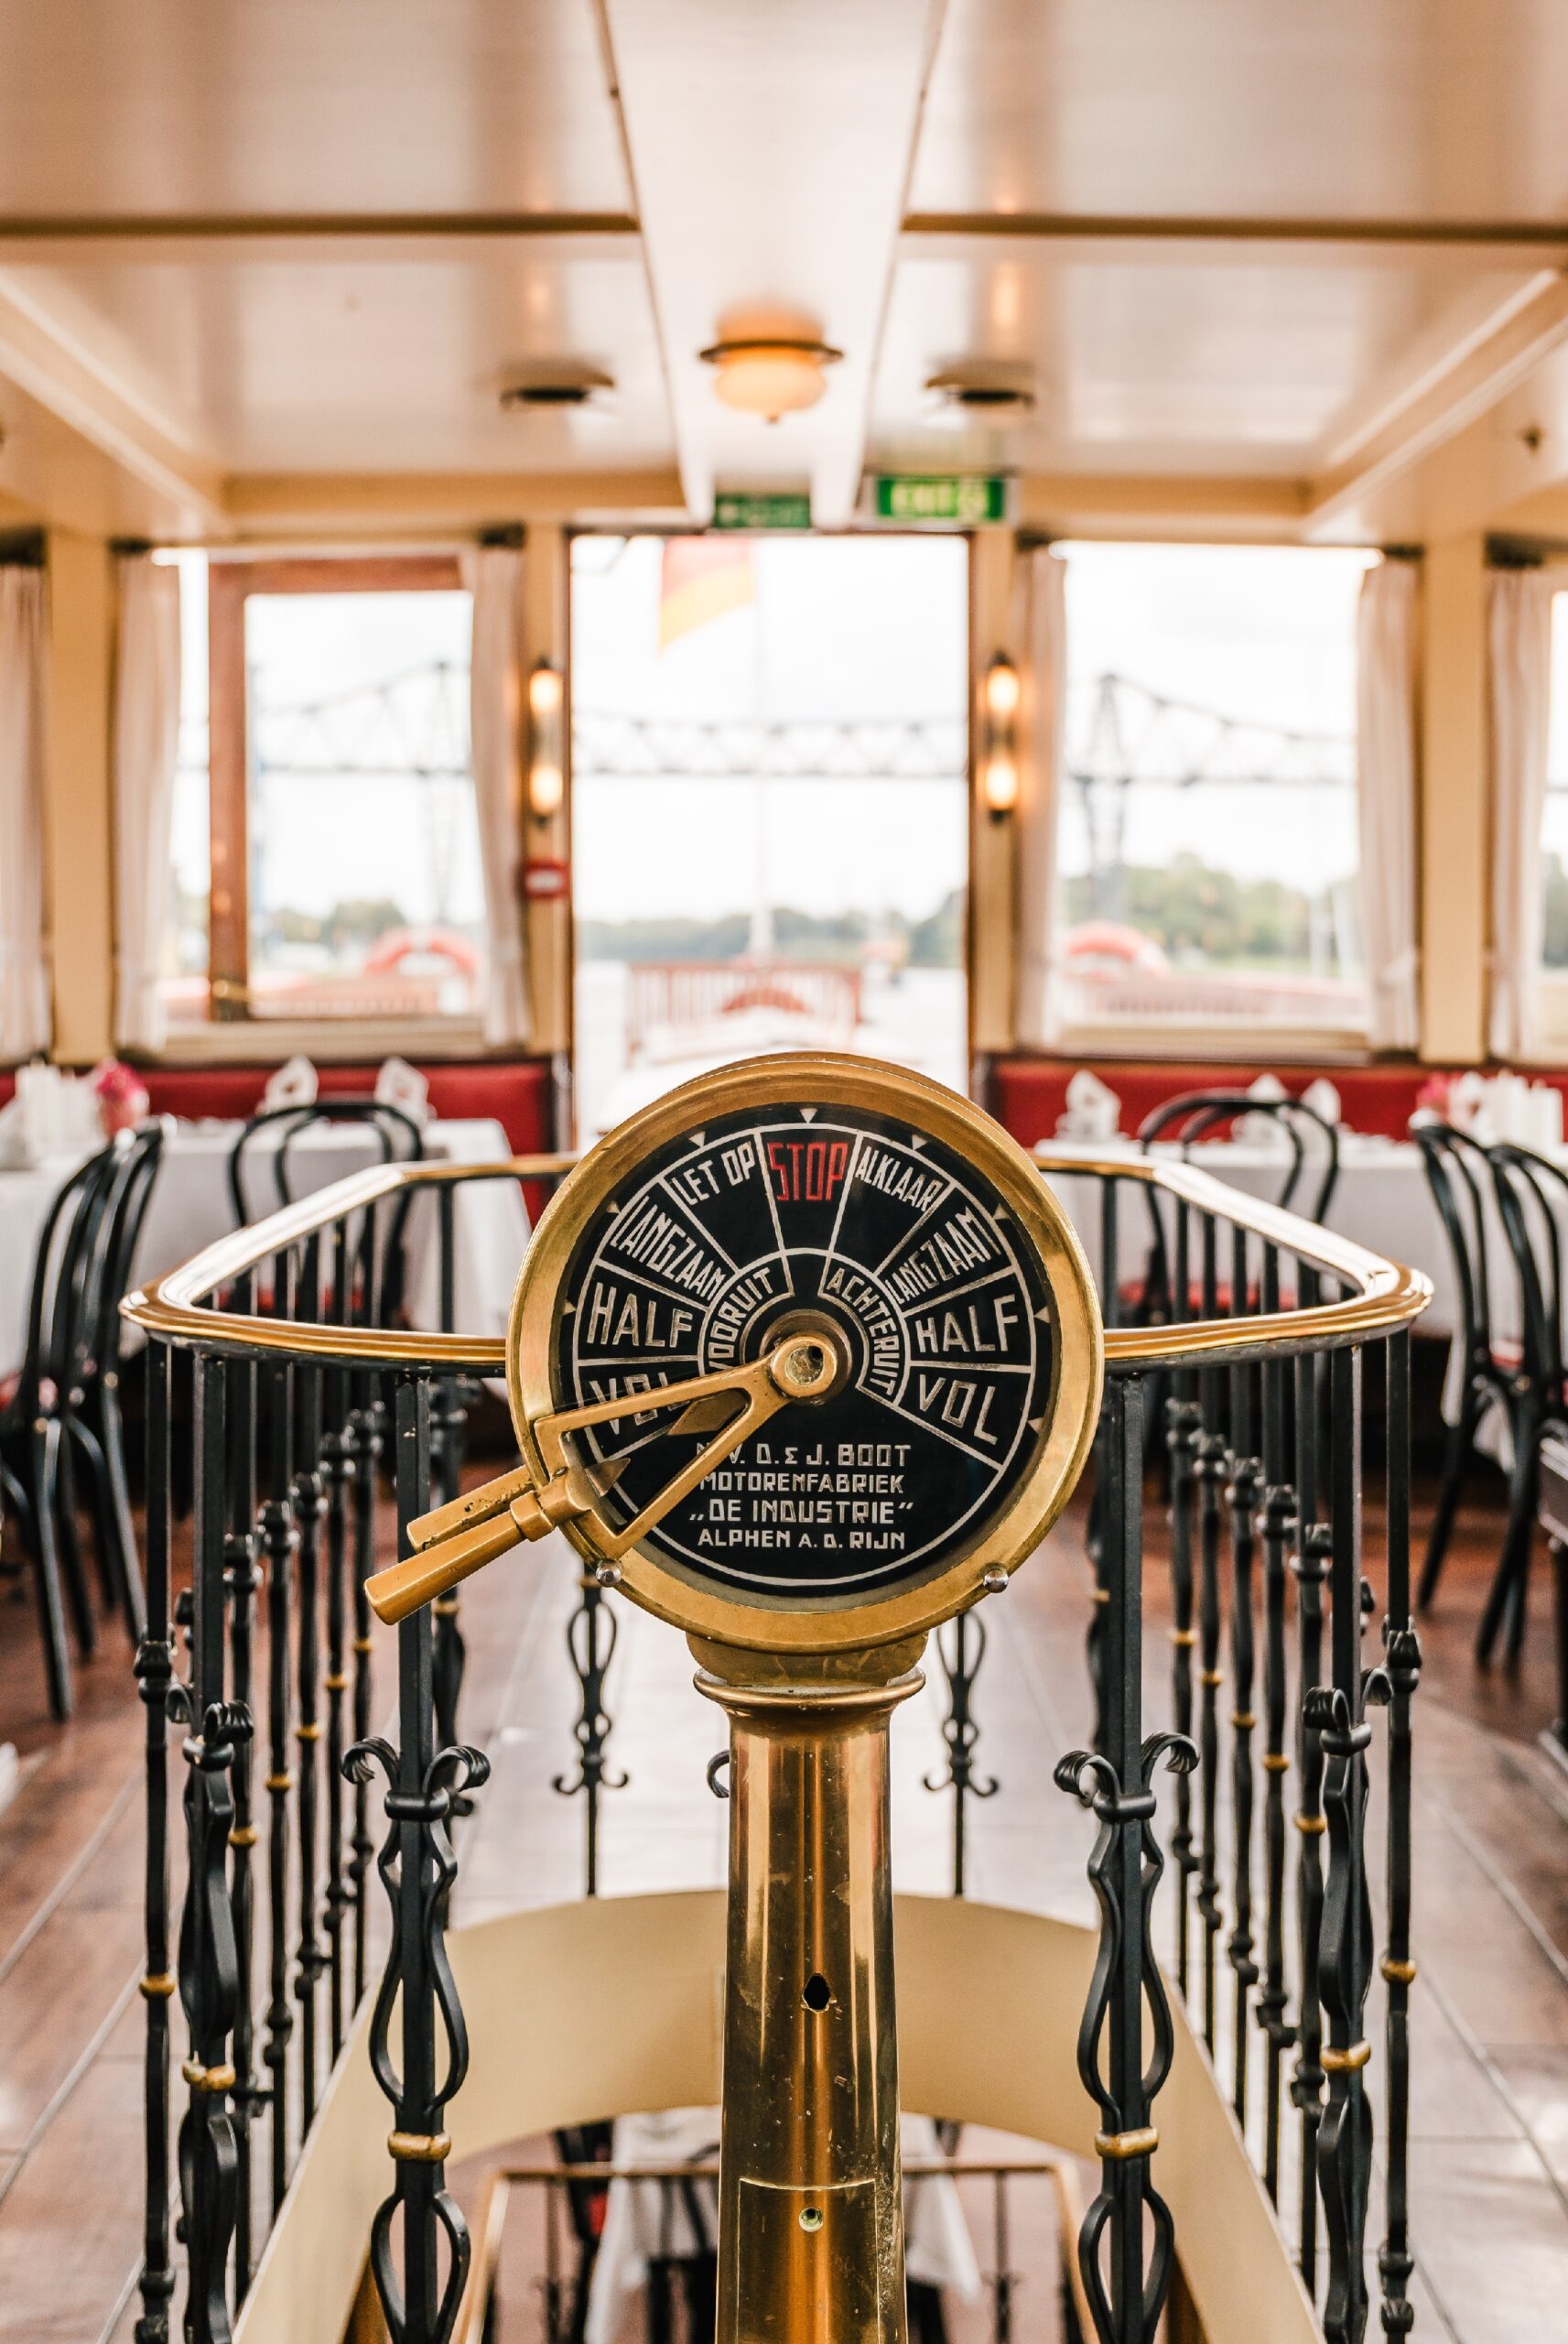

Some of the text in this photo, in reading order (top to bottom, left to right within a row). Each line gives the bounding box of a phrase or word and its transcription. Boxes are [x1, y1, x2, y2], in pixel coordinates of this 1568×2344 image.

[670, 1141, 756, 1206] LET OP
[767, 1142, 849, 1201] STOP
[854, 1145, 944, 1212] ALKLAAR
[610, 1196, 726, 1301] LANGZAAM
[884, 1206, 1002, 1305] LANGZAAM
[587, 1283, 693, 1348] HALF
[826, 1267, 901, 1395] ACHTERUIT
[915, 1294, 1019, 1353] HALF
[919, 1374, 999, 1445] VOL
[700, 1471, 904, 1494] MOTORENFABRIEK
[838, 1443, 912, 1467] BOOT
[697, 1528, 791, 1548] ALPHEN
[849, 1531, 905, 1550] RIJN
